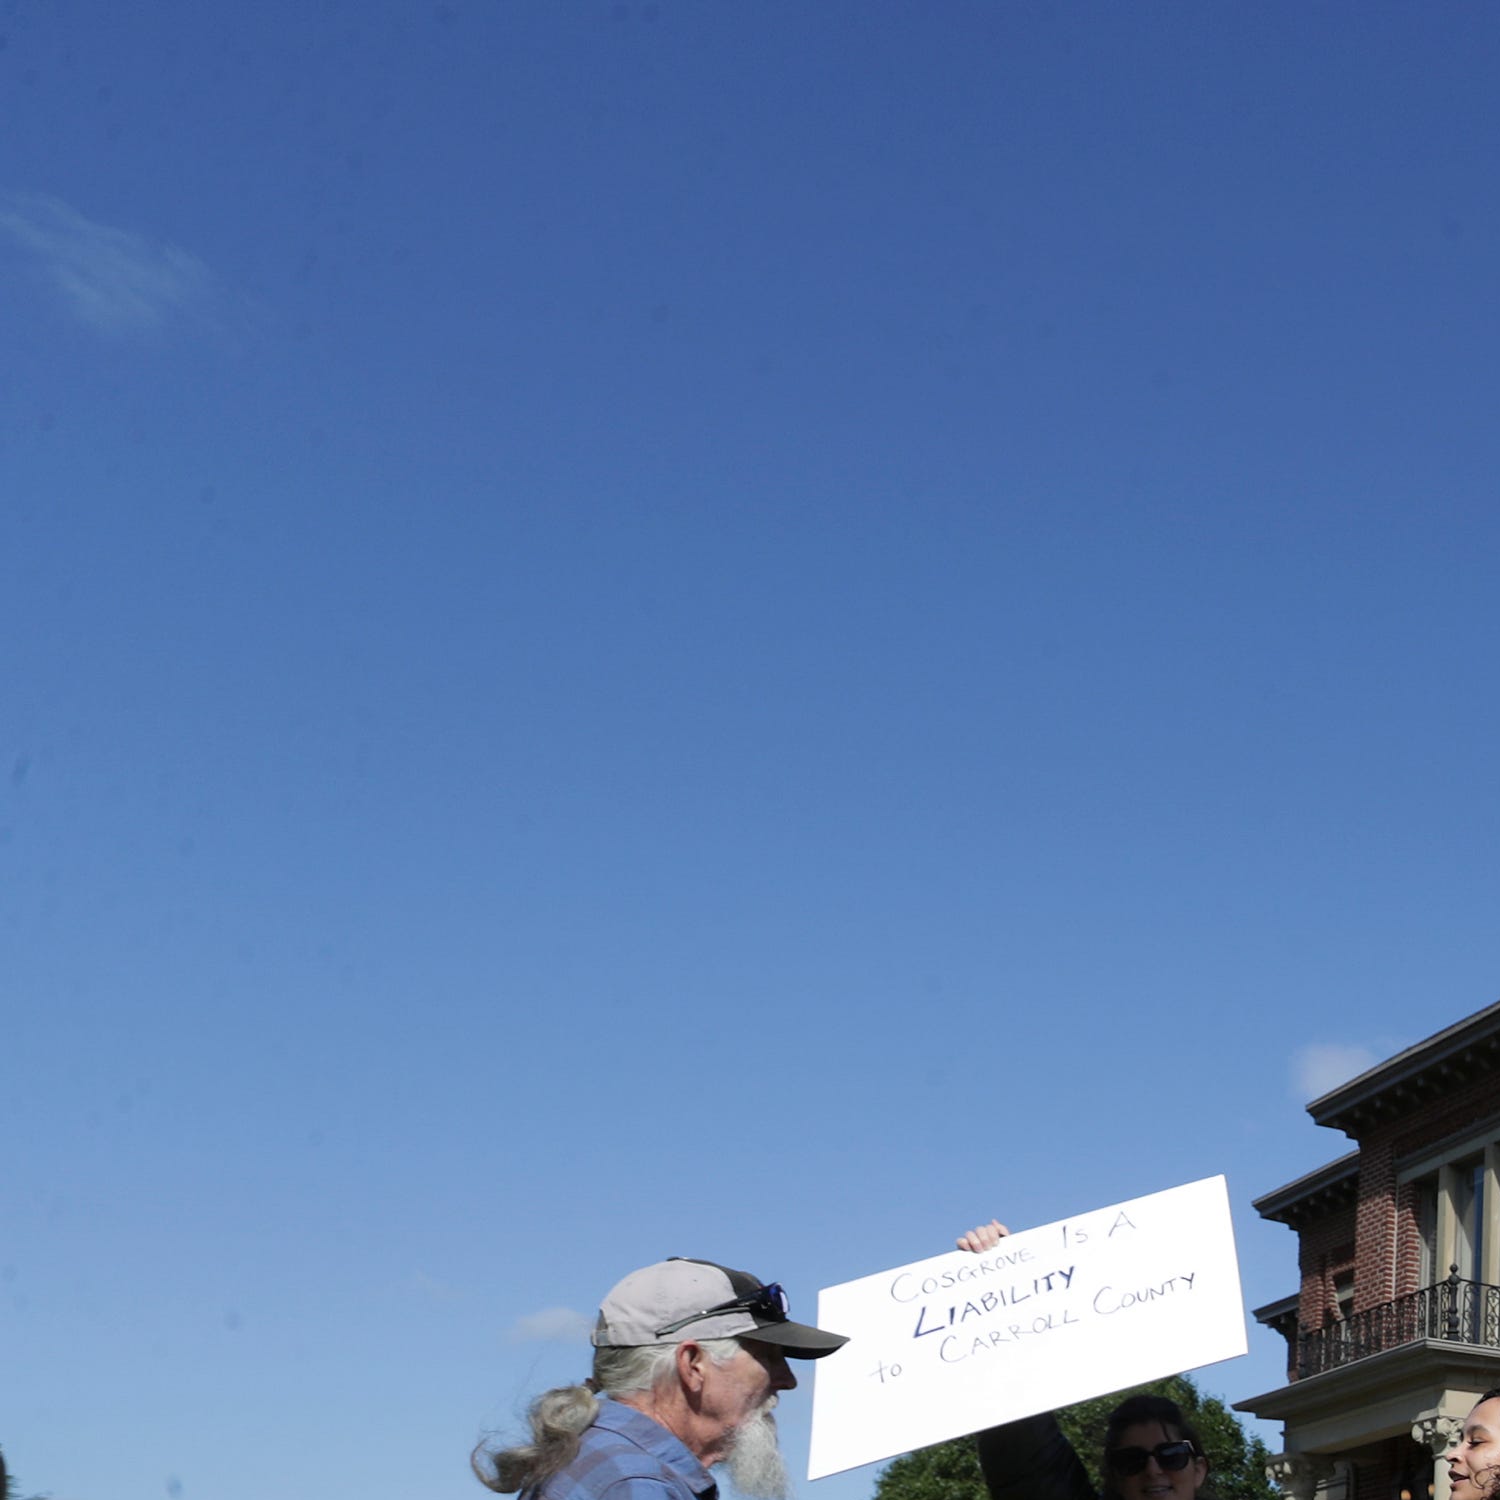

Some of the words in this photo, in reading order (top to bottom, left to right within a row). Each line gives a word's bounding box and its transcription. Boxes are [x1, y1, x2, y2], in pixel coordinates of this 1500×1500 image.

[890, 1246, 1036, 1303] COSGROVE
[1107, 1210, 1137, 1238] A
[913, 1265, 1075, 1339] LIABILITY
[868, 1360, 903, 1384] to
[939, 1309, 1080, 1364] CARROLL
[1092, 1271, 1196, 1315] COUNTY
